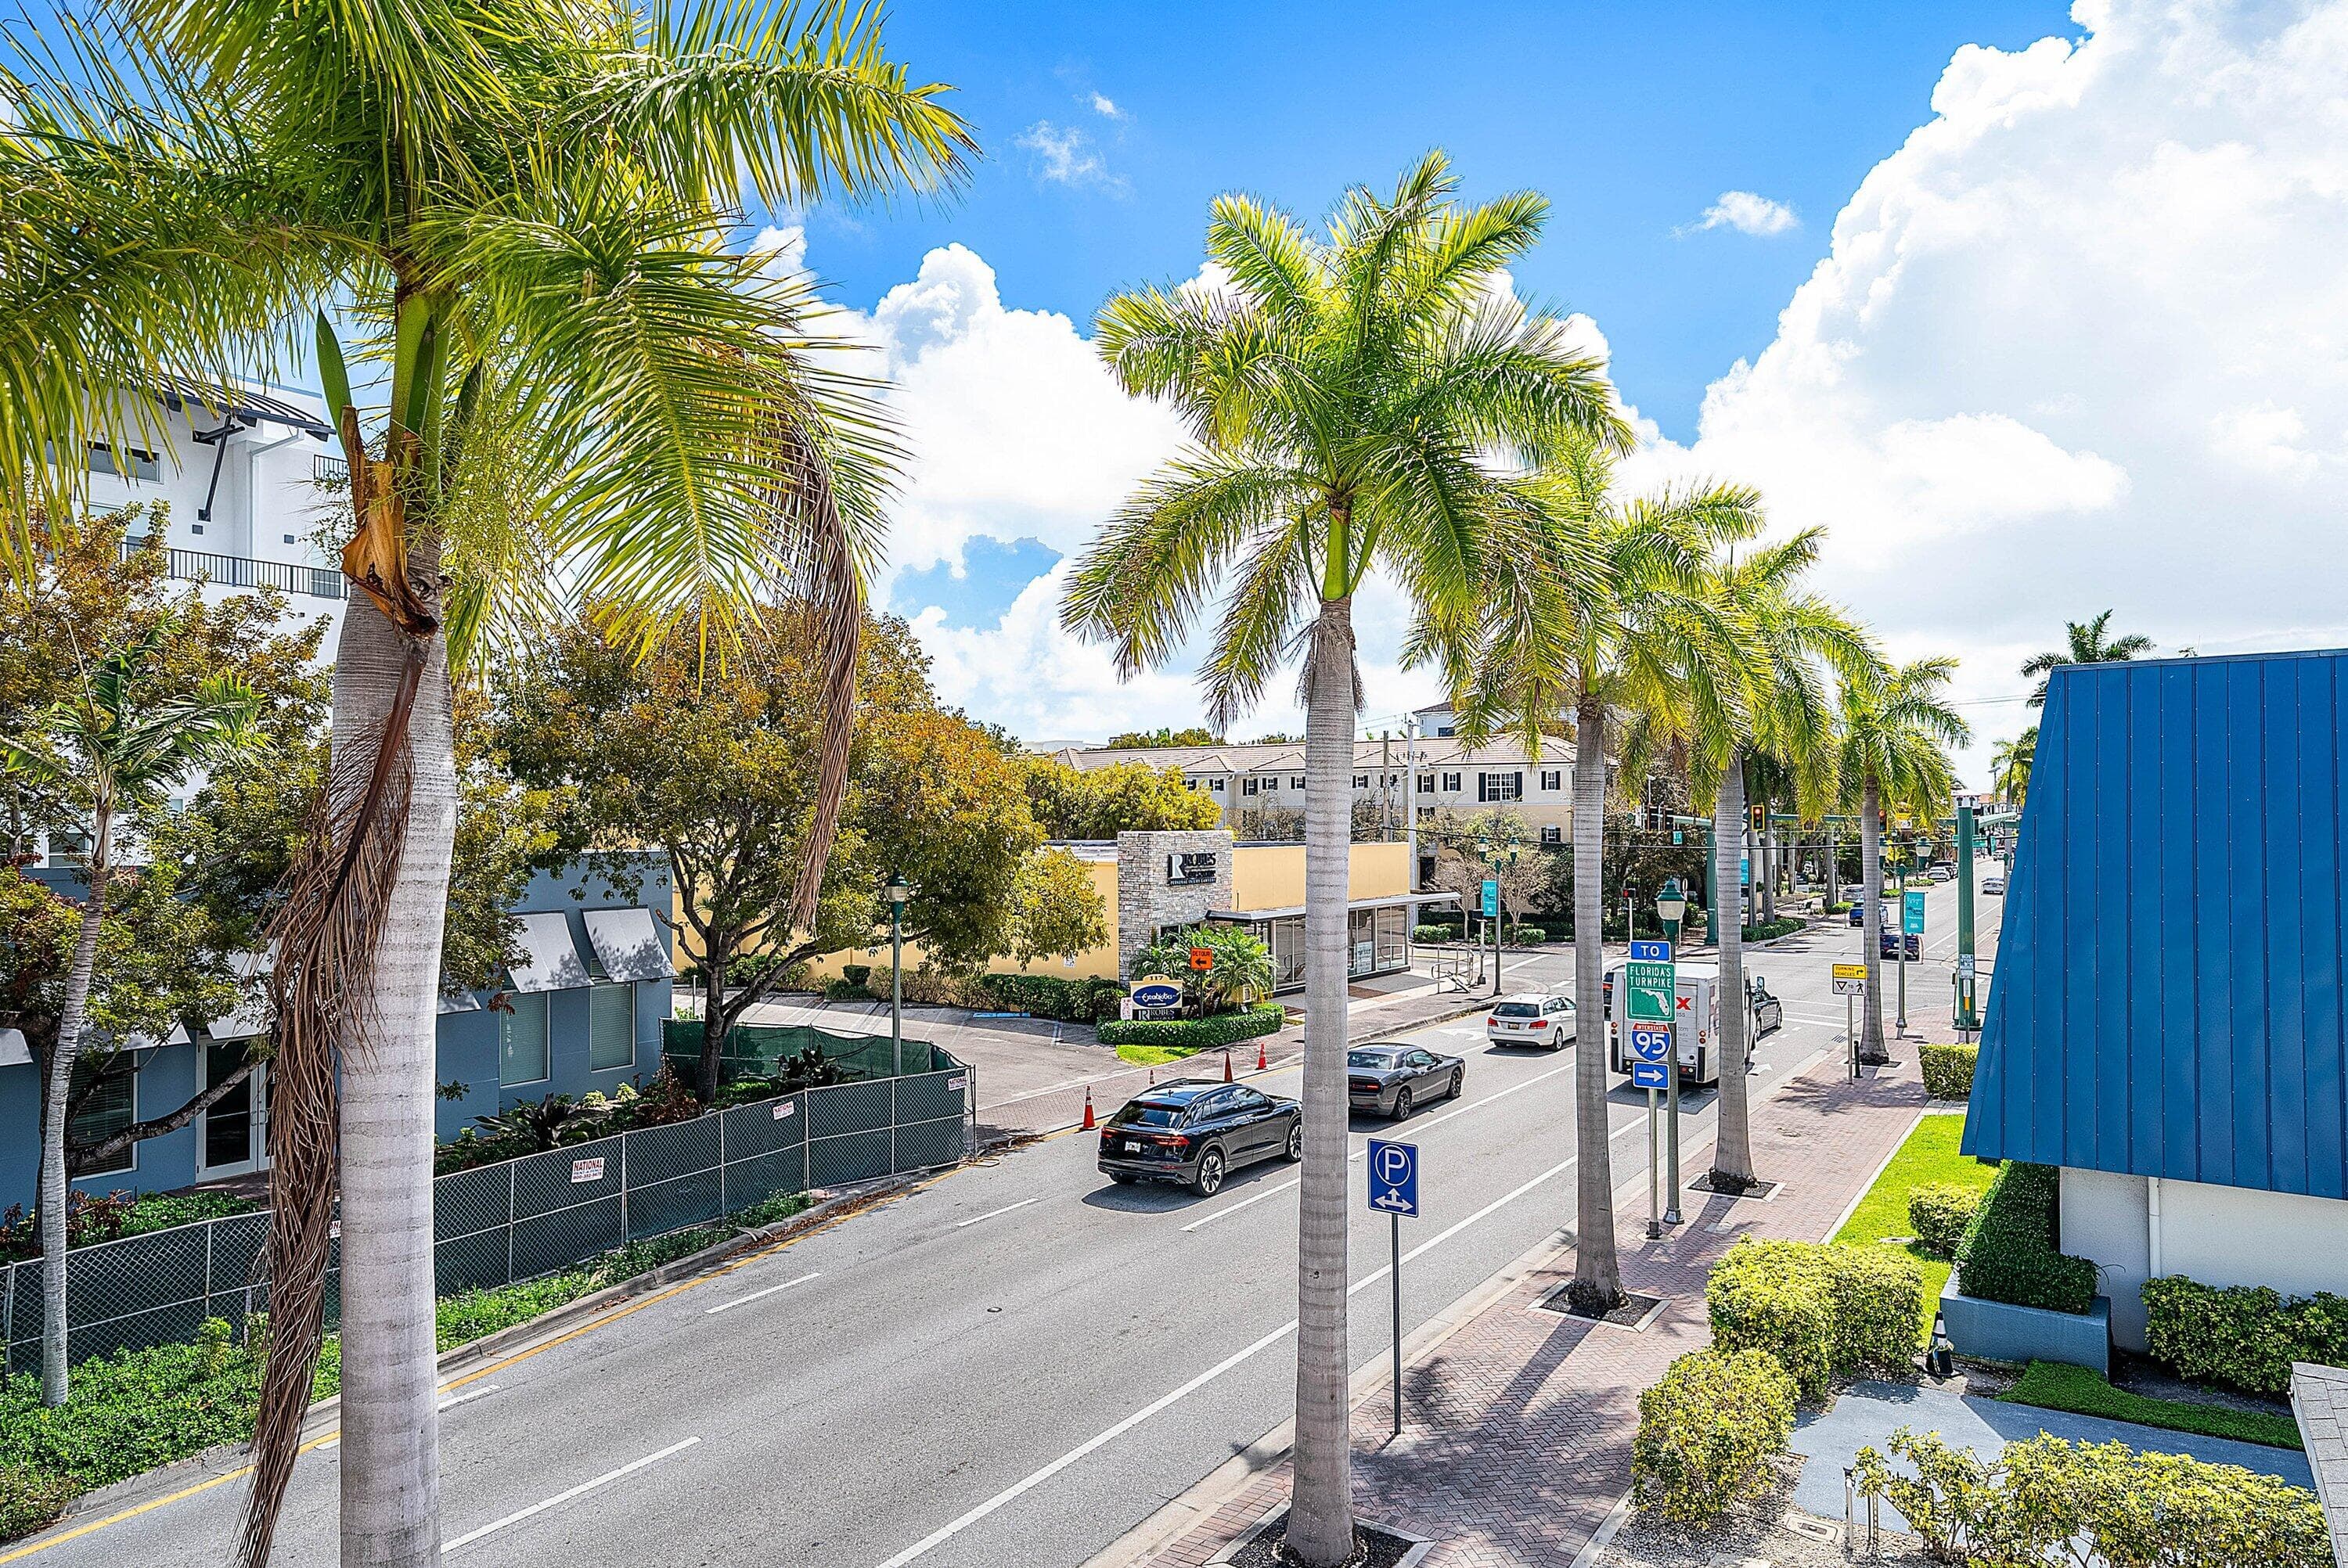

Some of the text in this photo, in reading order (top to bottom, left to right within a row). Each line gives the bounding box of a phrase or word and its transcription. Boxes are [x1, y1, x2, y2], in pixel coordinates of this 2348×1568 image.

[1640, 945, 1660, 957] TO
[1630, 966, 1671, 977] FLORIDA'S
[1630, 976, 1672, 988] TURNPIKE
[1636, 1032, 1666, 1054] 95
[574, 1158, 603, 1171] NATIONAL
[1385, 1149, 1406, 1181] P
